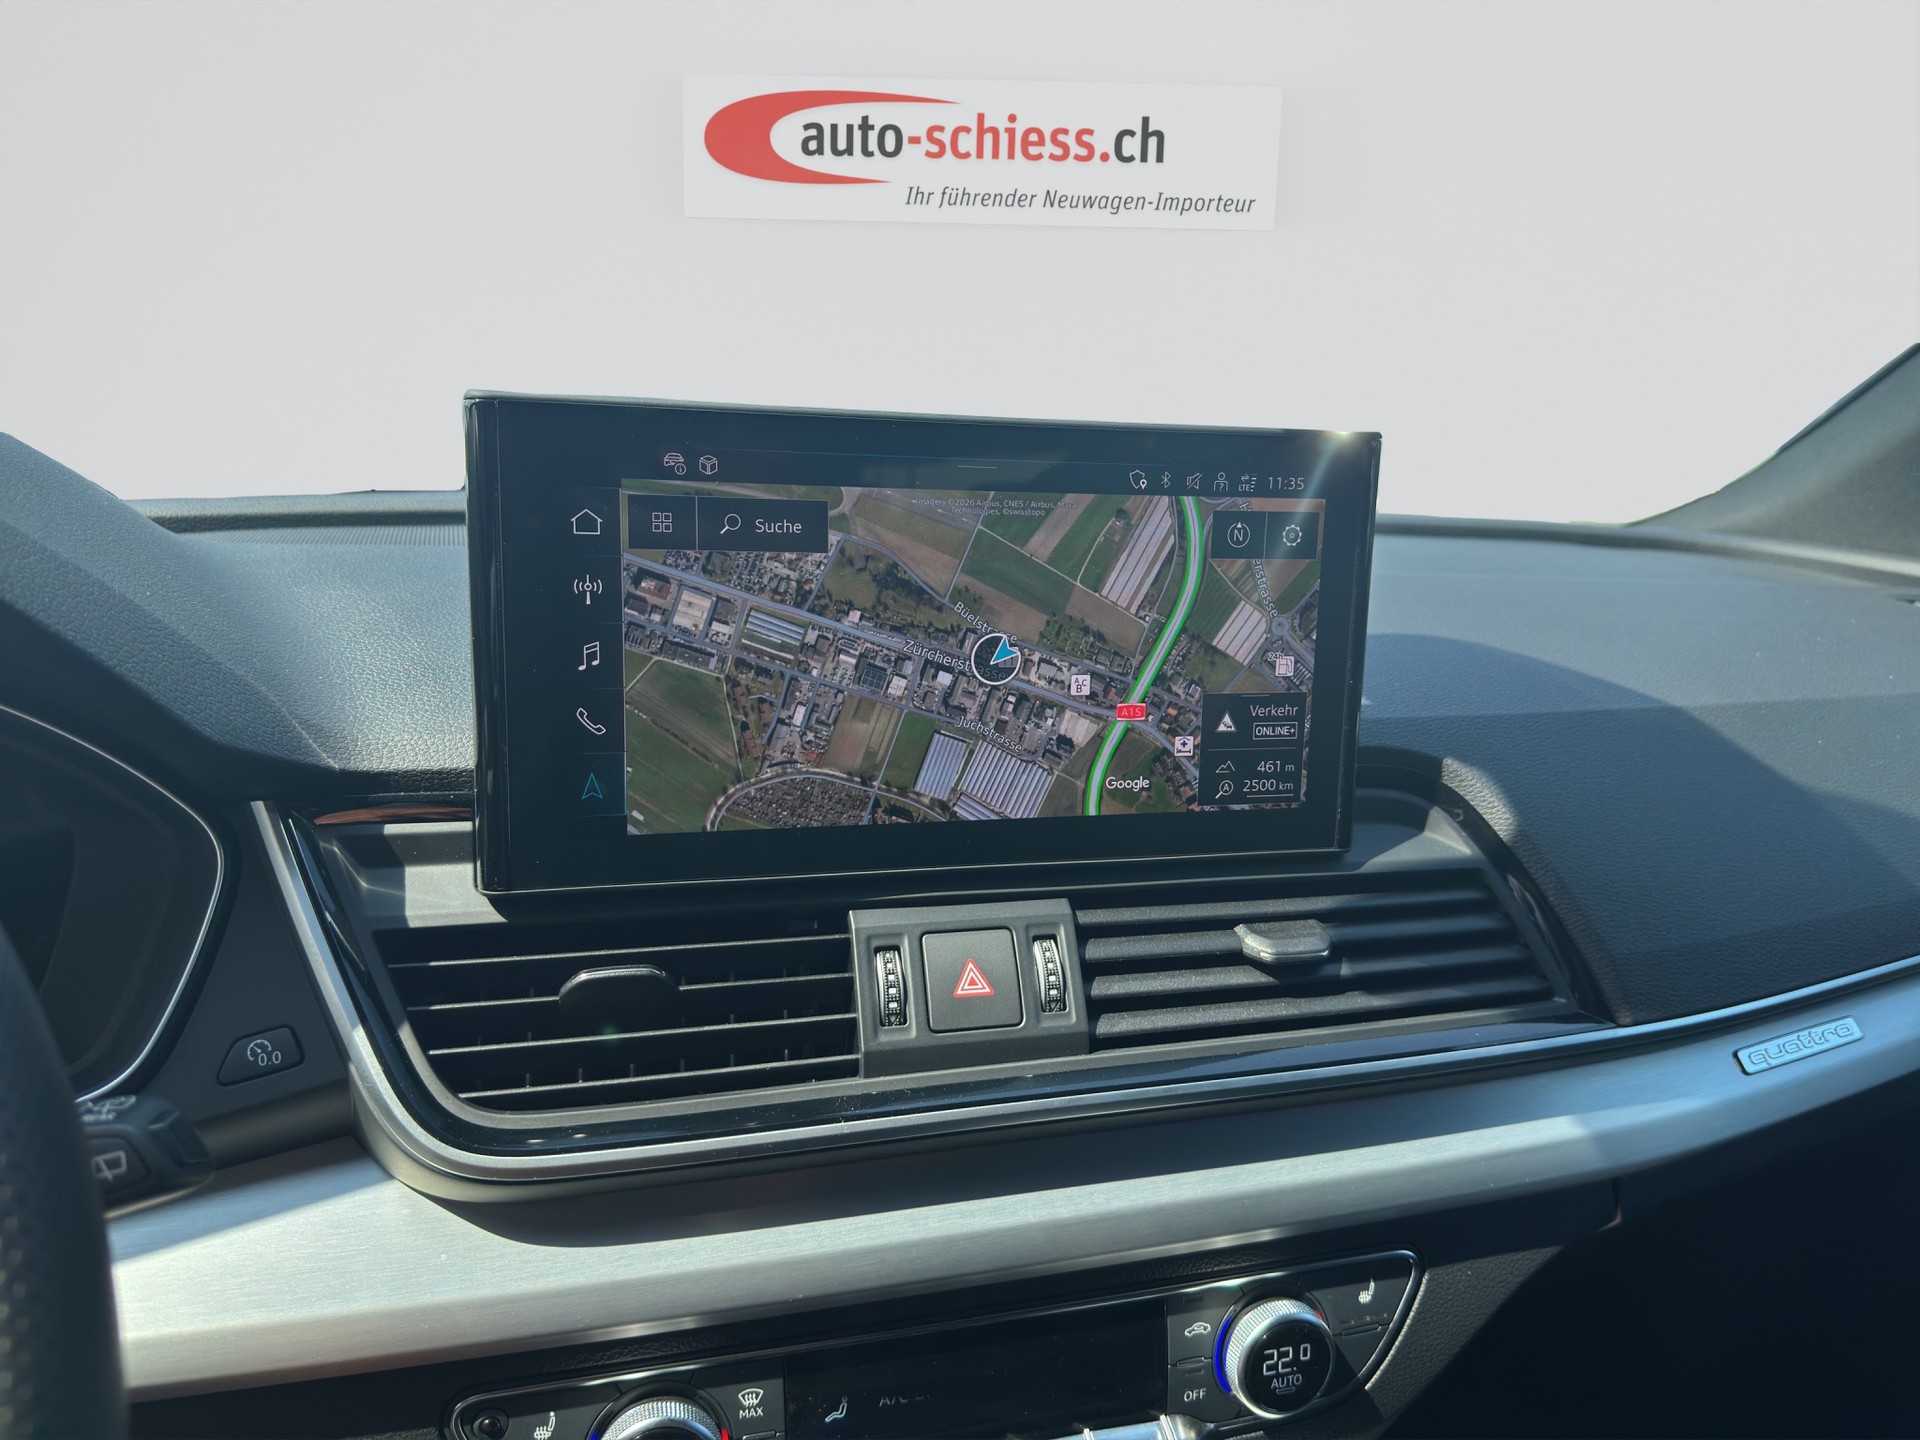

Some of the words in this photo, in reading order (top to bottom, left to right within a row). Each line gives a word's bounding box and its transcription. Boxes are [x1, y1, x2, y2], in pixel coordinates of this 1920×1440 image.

[801, 112, 1165, 163] auto-schiess.ch
[905, 186, 935, 205] Ihr
[938, 186, 1037, 209] führender
[1043, 189, 1257, 216] Neuwagen-Importeur
[1238, 484, 1250, 492] LTE
[1267, 476, 1305, 490] 11:35
[1003, 500, 1024, 508] CNES
[755, 518, 803, 534] Suche
[1121, 707, 1142, 716] A15
[1250, 704, 1299, 717] Verkehr
[957, 715, 1022, 753] Juchstrasse
[1255, 725, 1296, 736] ONLINE+
[1257, 760, 1281, 773] 461
[1105, 775, 1150, 792] Google
[1242, 780, 1276, 792] 2500
[1279, 781, 1294, 790] km
[1747, 1023, 1855, 1067] quattro
[258, 1051, 282, 1066] 0.0
[1270, 1373, 1302, 1389] AUTO
[1183, 1387, 1207, 1402] OFF
[738, 1406, 764, 1419] MAX
